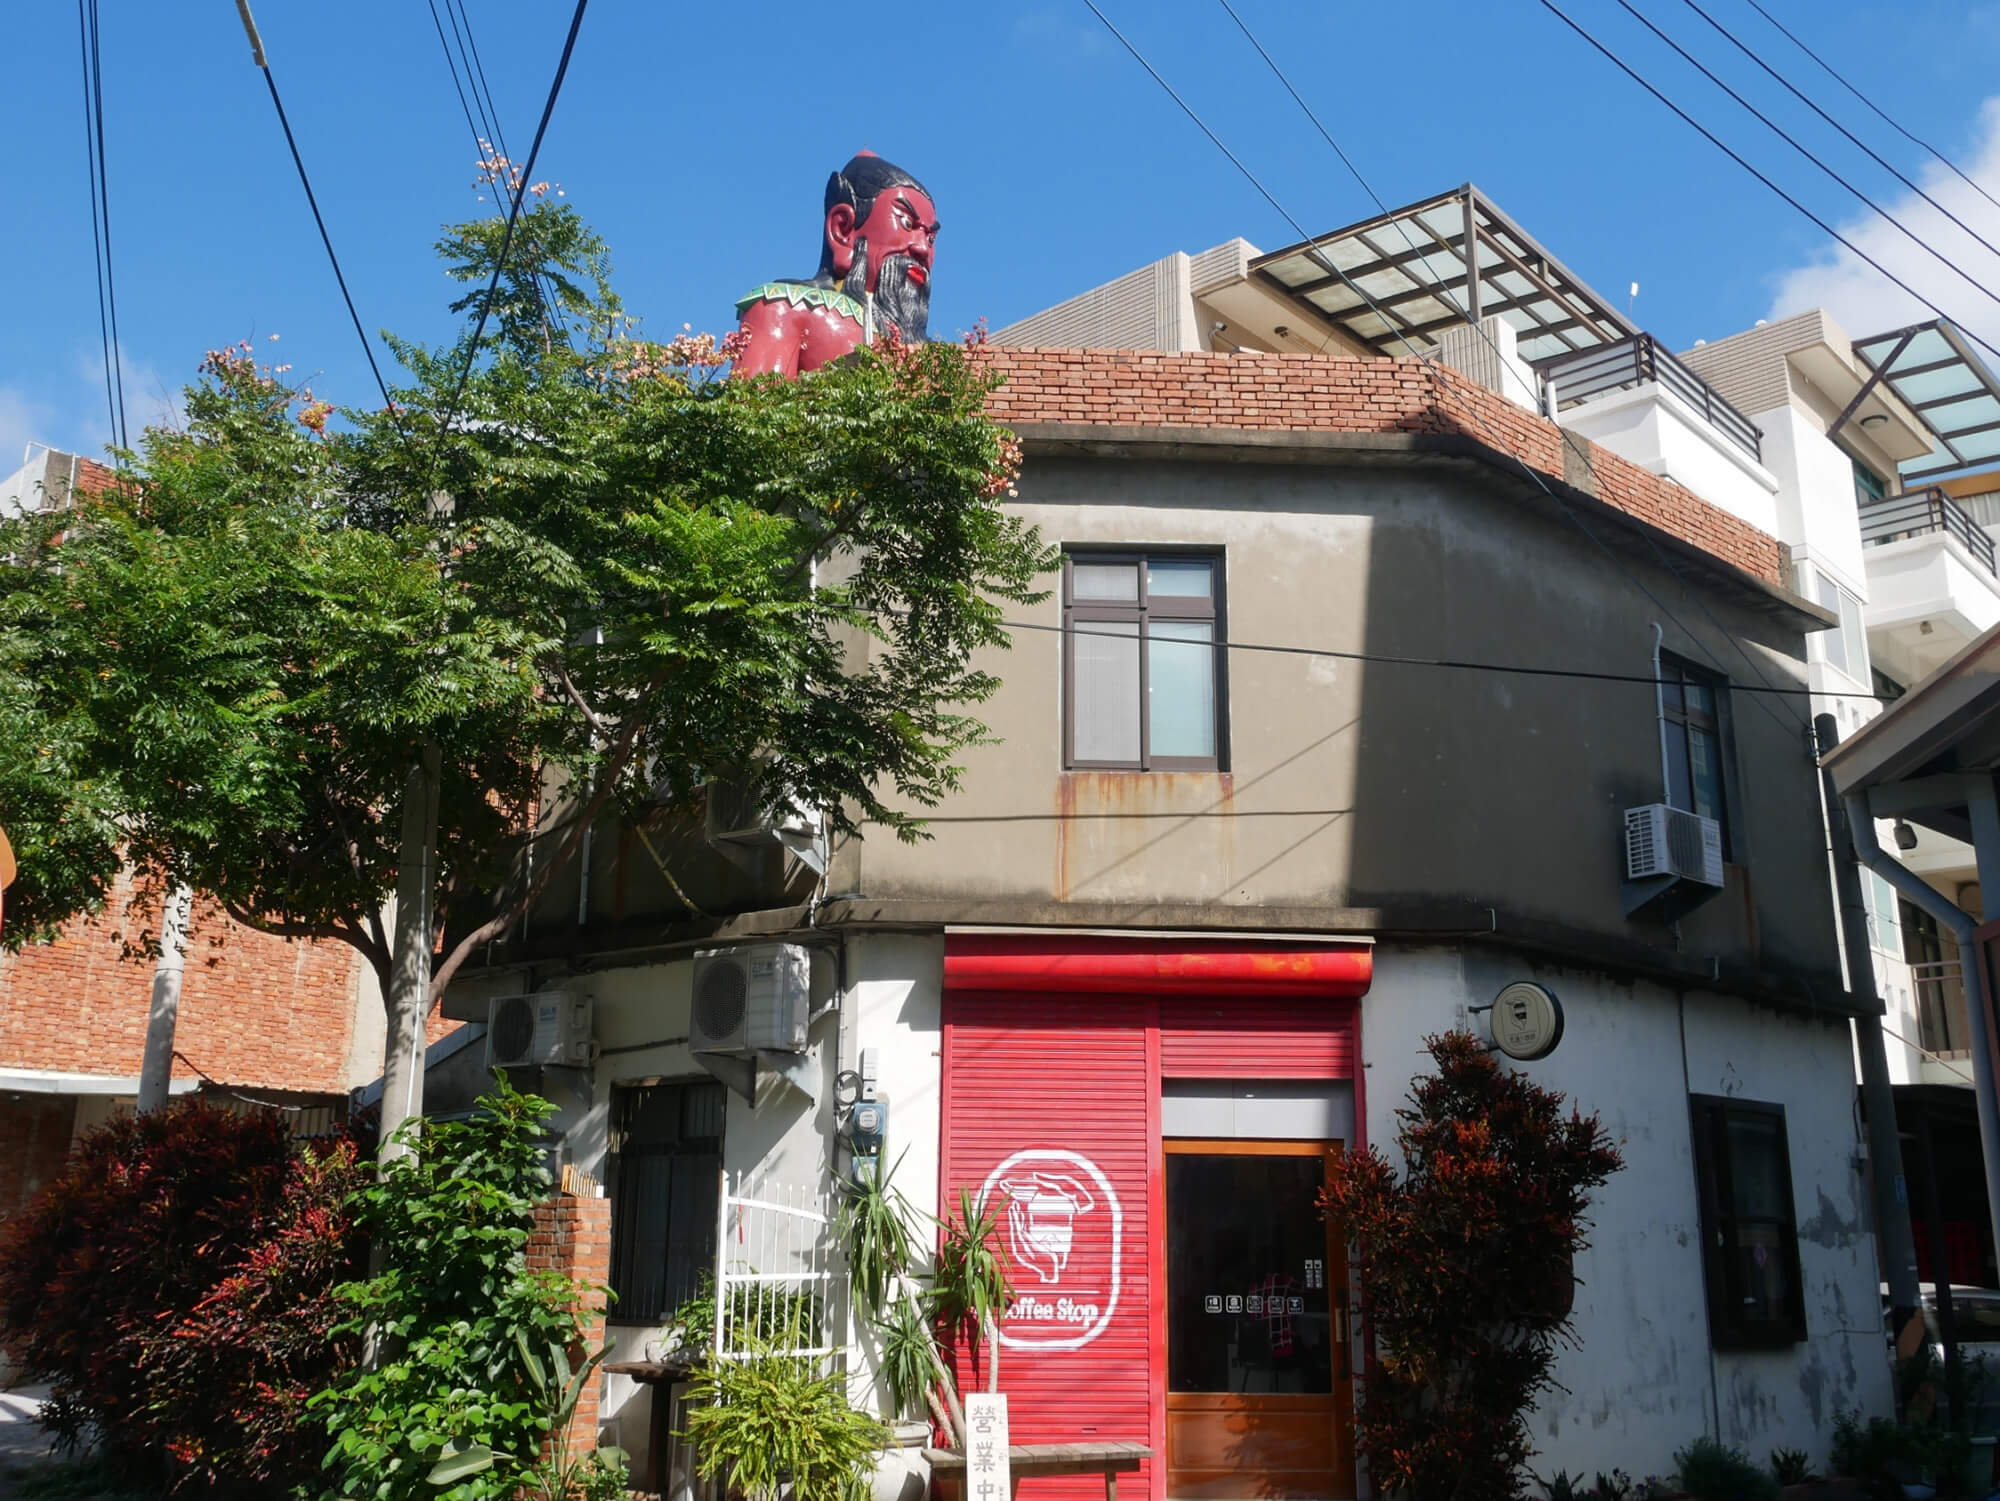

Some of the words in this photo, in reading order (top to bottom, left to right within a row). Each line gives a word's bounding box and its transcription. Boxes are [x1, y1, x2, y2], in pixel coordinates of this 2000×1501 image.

[1056, 1297, 1099, 1328] Stop
[972, 1404, 997, 1501] 營業中
